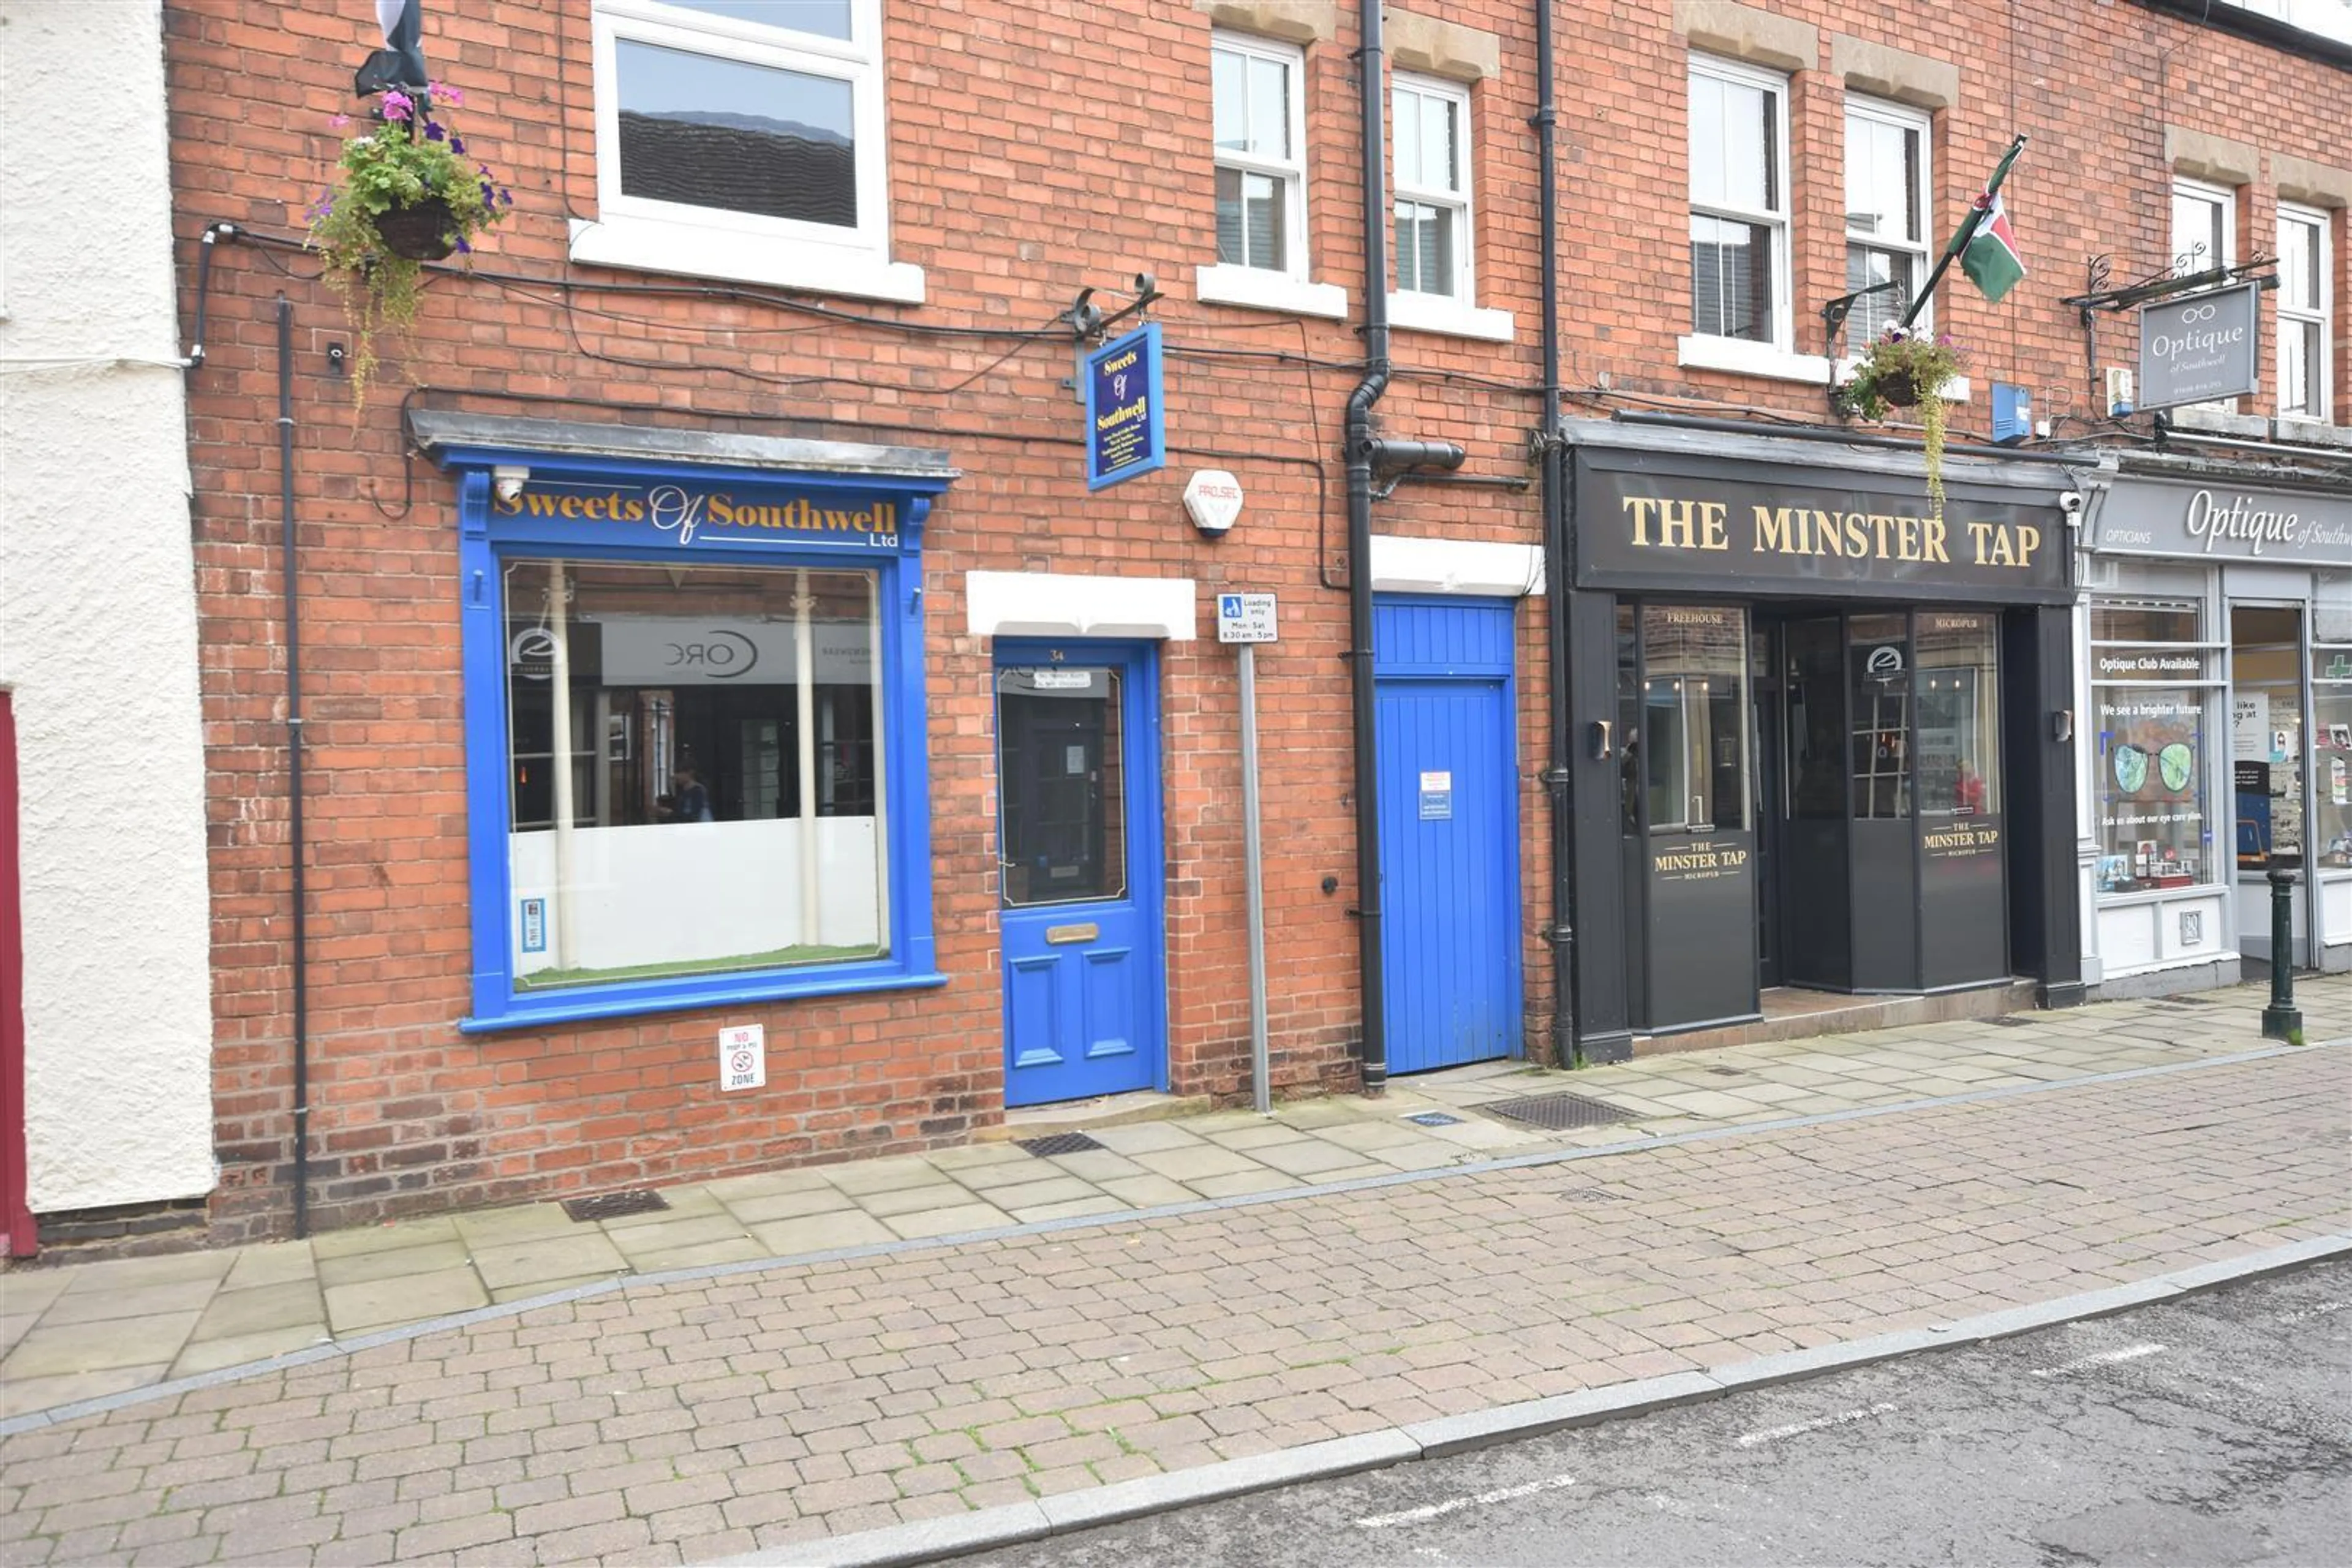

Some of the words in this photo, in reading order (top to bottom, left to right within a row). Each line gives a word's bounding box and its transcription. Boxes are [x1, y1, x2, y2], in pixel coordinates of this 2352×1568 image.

[2153, 326, 2242, 361] Optique
[1104, 350, 1137, 376] Sweets
[1098, 396, 1145, 431] Southwell
[648, 484, 704, 545] Of
[707, 493, 895, 533] Southwell
[2187, 489, 2298, 556] Optique
[2298, 521, 2316, 549] of
[1623, 496, 1728, 551] THE
[1752, 505, 1950, 563] MINSTER
[1967, 522, 2040, 567] TAP
[2106, 529, 2152, 544] OPTICIANS
[870, 532, 899, 547] Ltd
[1668, 612, 1723, 624] FREEHOUSE
[2100, 657, 2136, 673] Optique
[2138, 657, 2158, 669] Club
[2159, 657, 2200, 670] Available
[2100, 704, 2114, 715] We
[2116, 707, 2131, 715] see
[2140, 703, 2174, 718] brighter
[2237, 701, 2256, 709] like
[1953, 822, 1970, 831] THE
[1691, 842, 1711, 851] THE
[1924, 832, 1974, 849] MINSTER
[1977, 831, 1998, 844] TAP
[1655, 853, 1717, 872] MINSTER
[1721, 850, 1747, 865] TAP
[1684, 871, 1719, 880] MICROPUB
[734, 1031, 748, 1042] NO
[731, 1072, 756, 1085] ZONE
